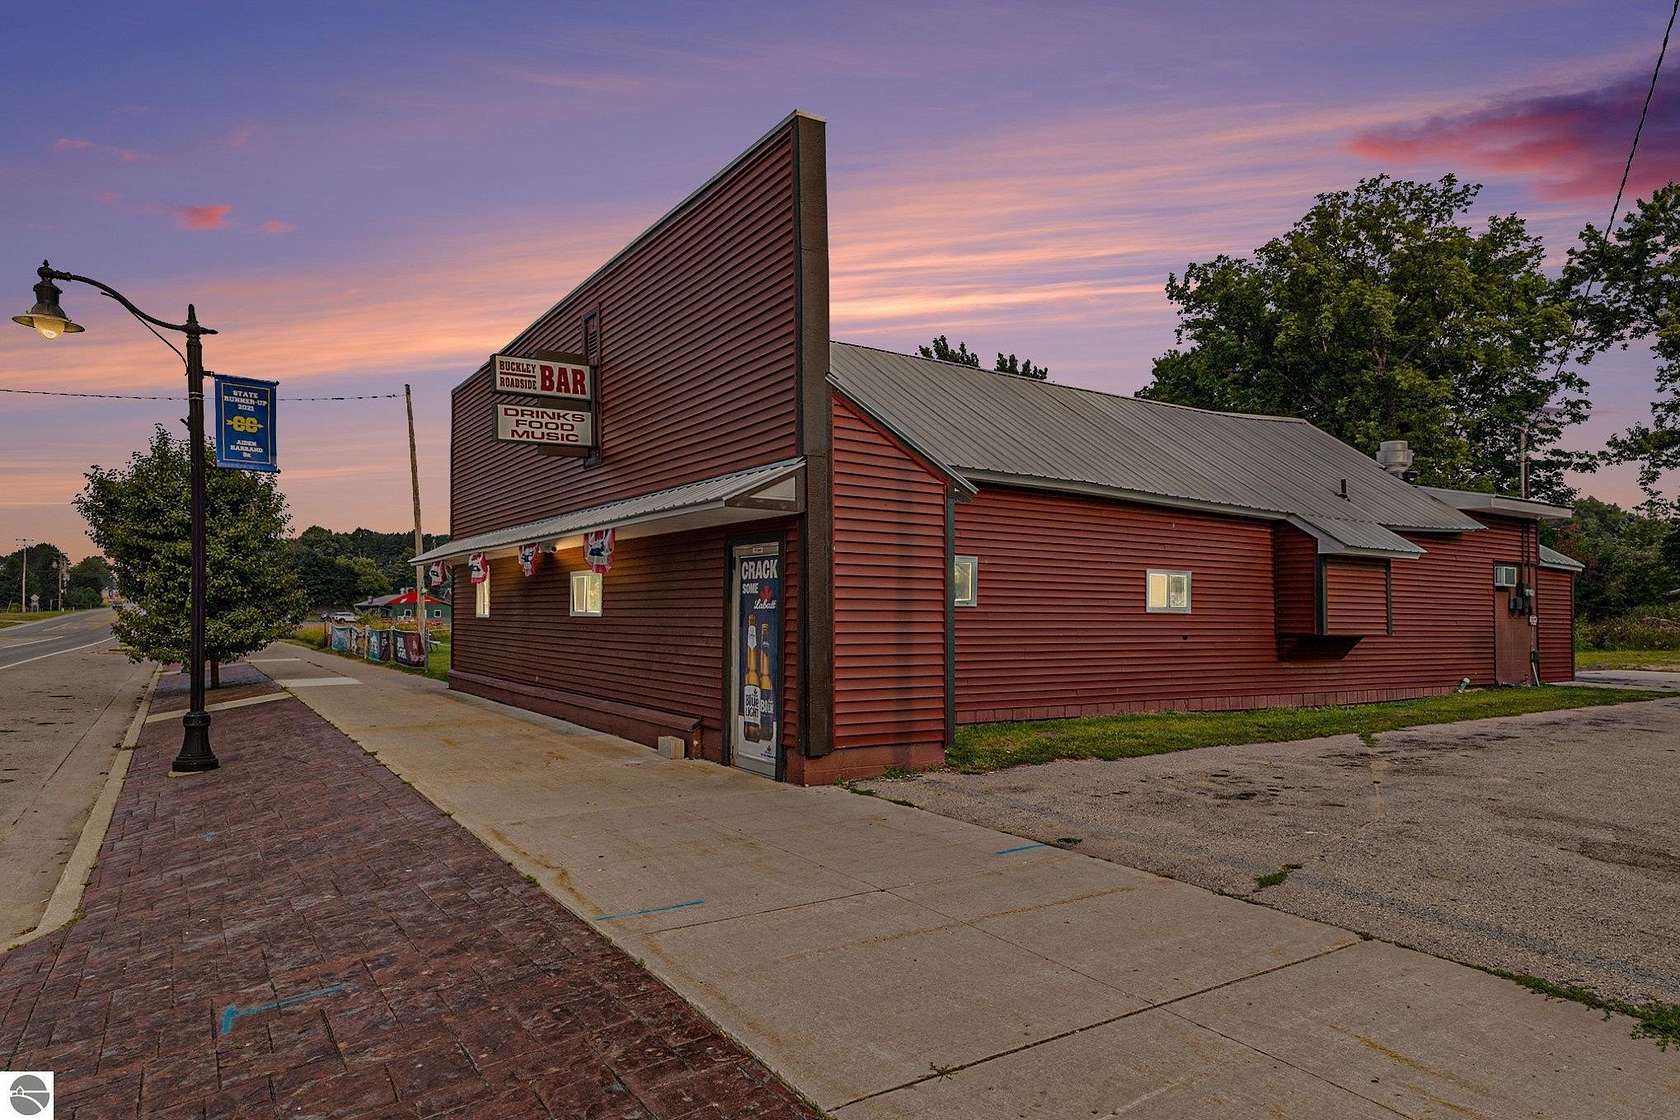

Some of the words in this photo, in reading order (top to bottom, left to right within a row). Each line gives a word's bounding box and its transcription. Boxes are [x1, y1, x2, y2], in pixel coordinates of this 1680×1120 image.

[499, 360, 536, 374] BUCKLEY
[499, 376, 537, 390] ROADSIDE
[539, 364, 587, 396] BAR
[223, 395, 267, 406] RUNNER-UP
[233, 390, 258, 399] STATE
[503, 407, 585, 422] DRINKS
[515, 419, 575, 432] FOOD
[510, 429, 579, 442] MUSIC
[741, 559, 778, 580] CRACK
[742, 582, 759, 594] SOME
[753, 598, 777, 610] Labatt
